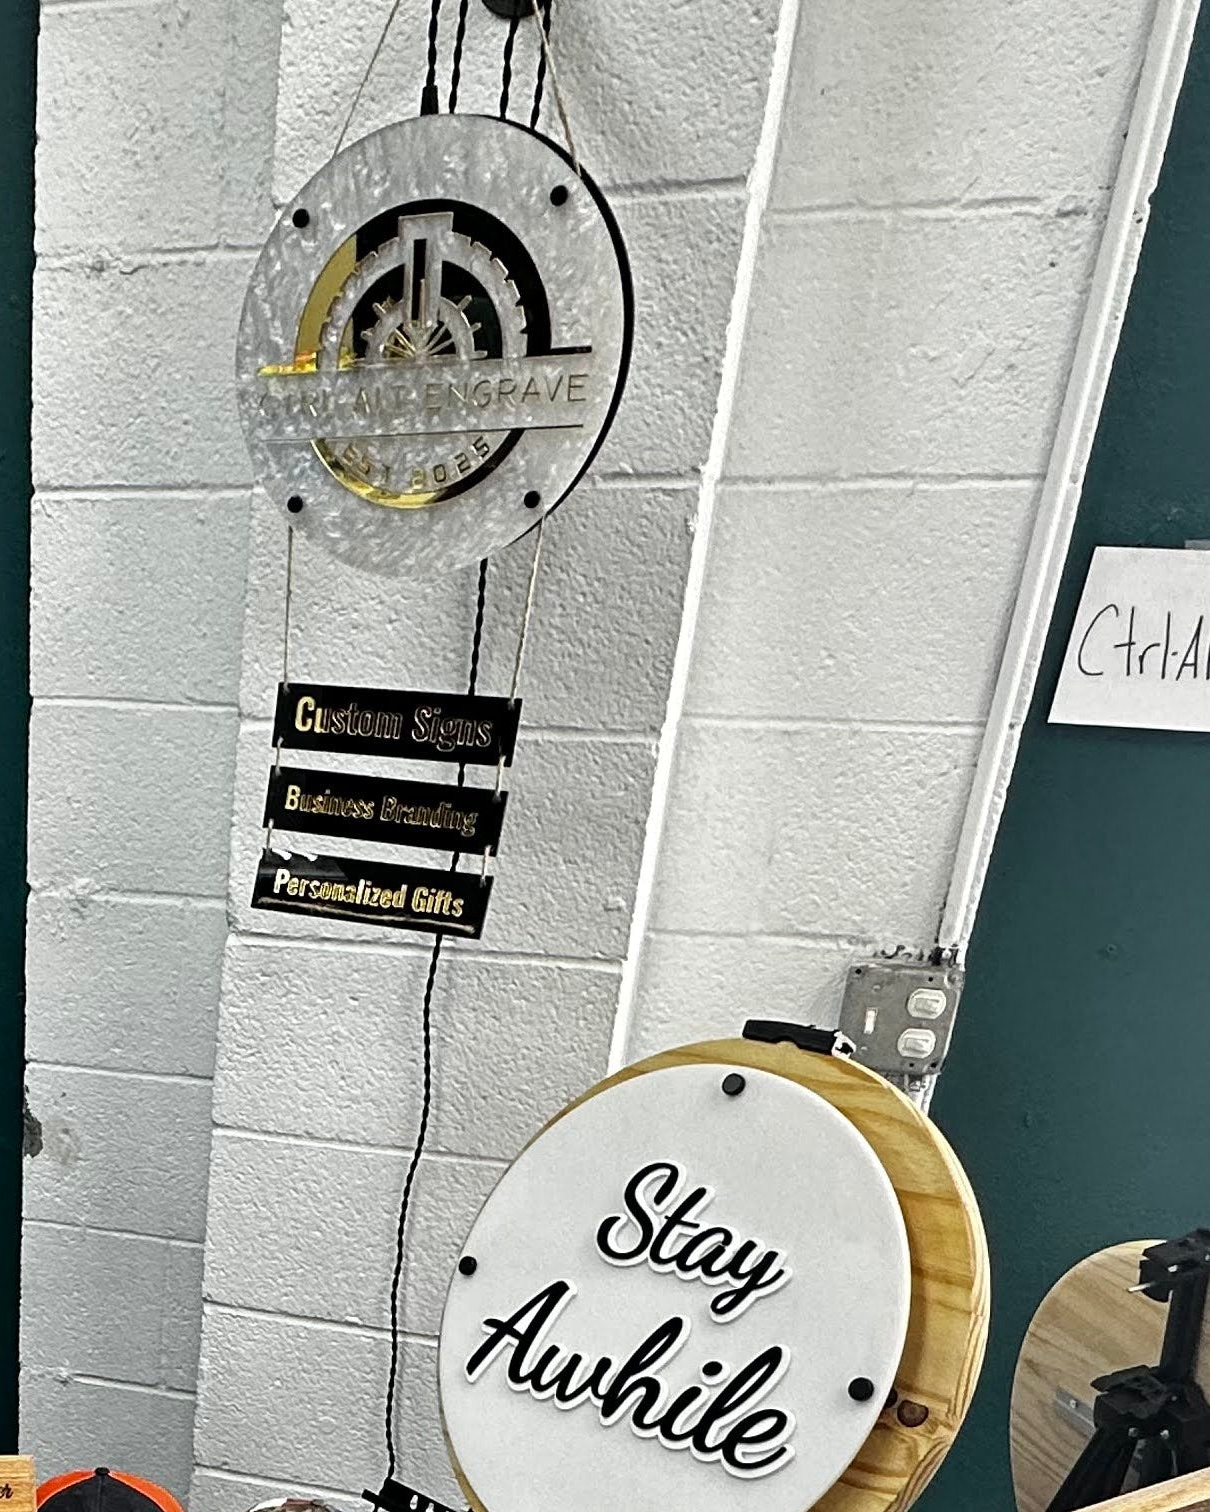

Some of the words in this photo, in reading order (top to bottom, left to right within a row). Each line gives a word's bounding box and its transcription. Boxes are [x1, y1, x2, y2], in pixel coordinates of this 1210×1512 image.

[294, 696, 403, 740] Custom
[412, 705, 493, 752] Signs
[285, 785, 375, 819] Business
[380, 796, 479, 836] Branding
[273, 868, 407, 909] Personalized
[411, 887, 464, 917] Gifts
[596, 1162, 785, 1316] Stay
[465, 1280, 789, 1470] Awhile
